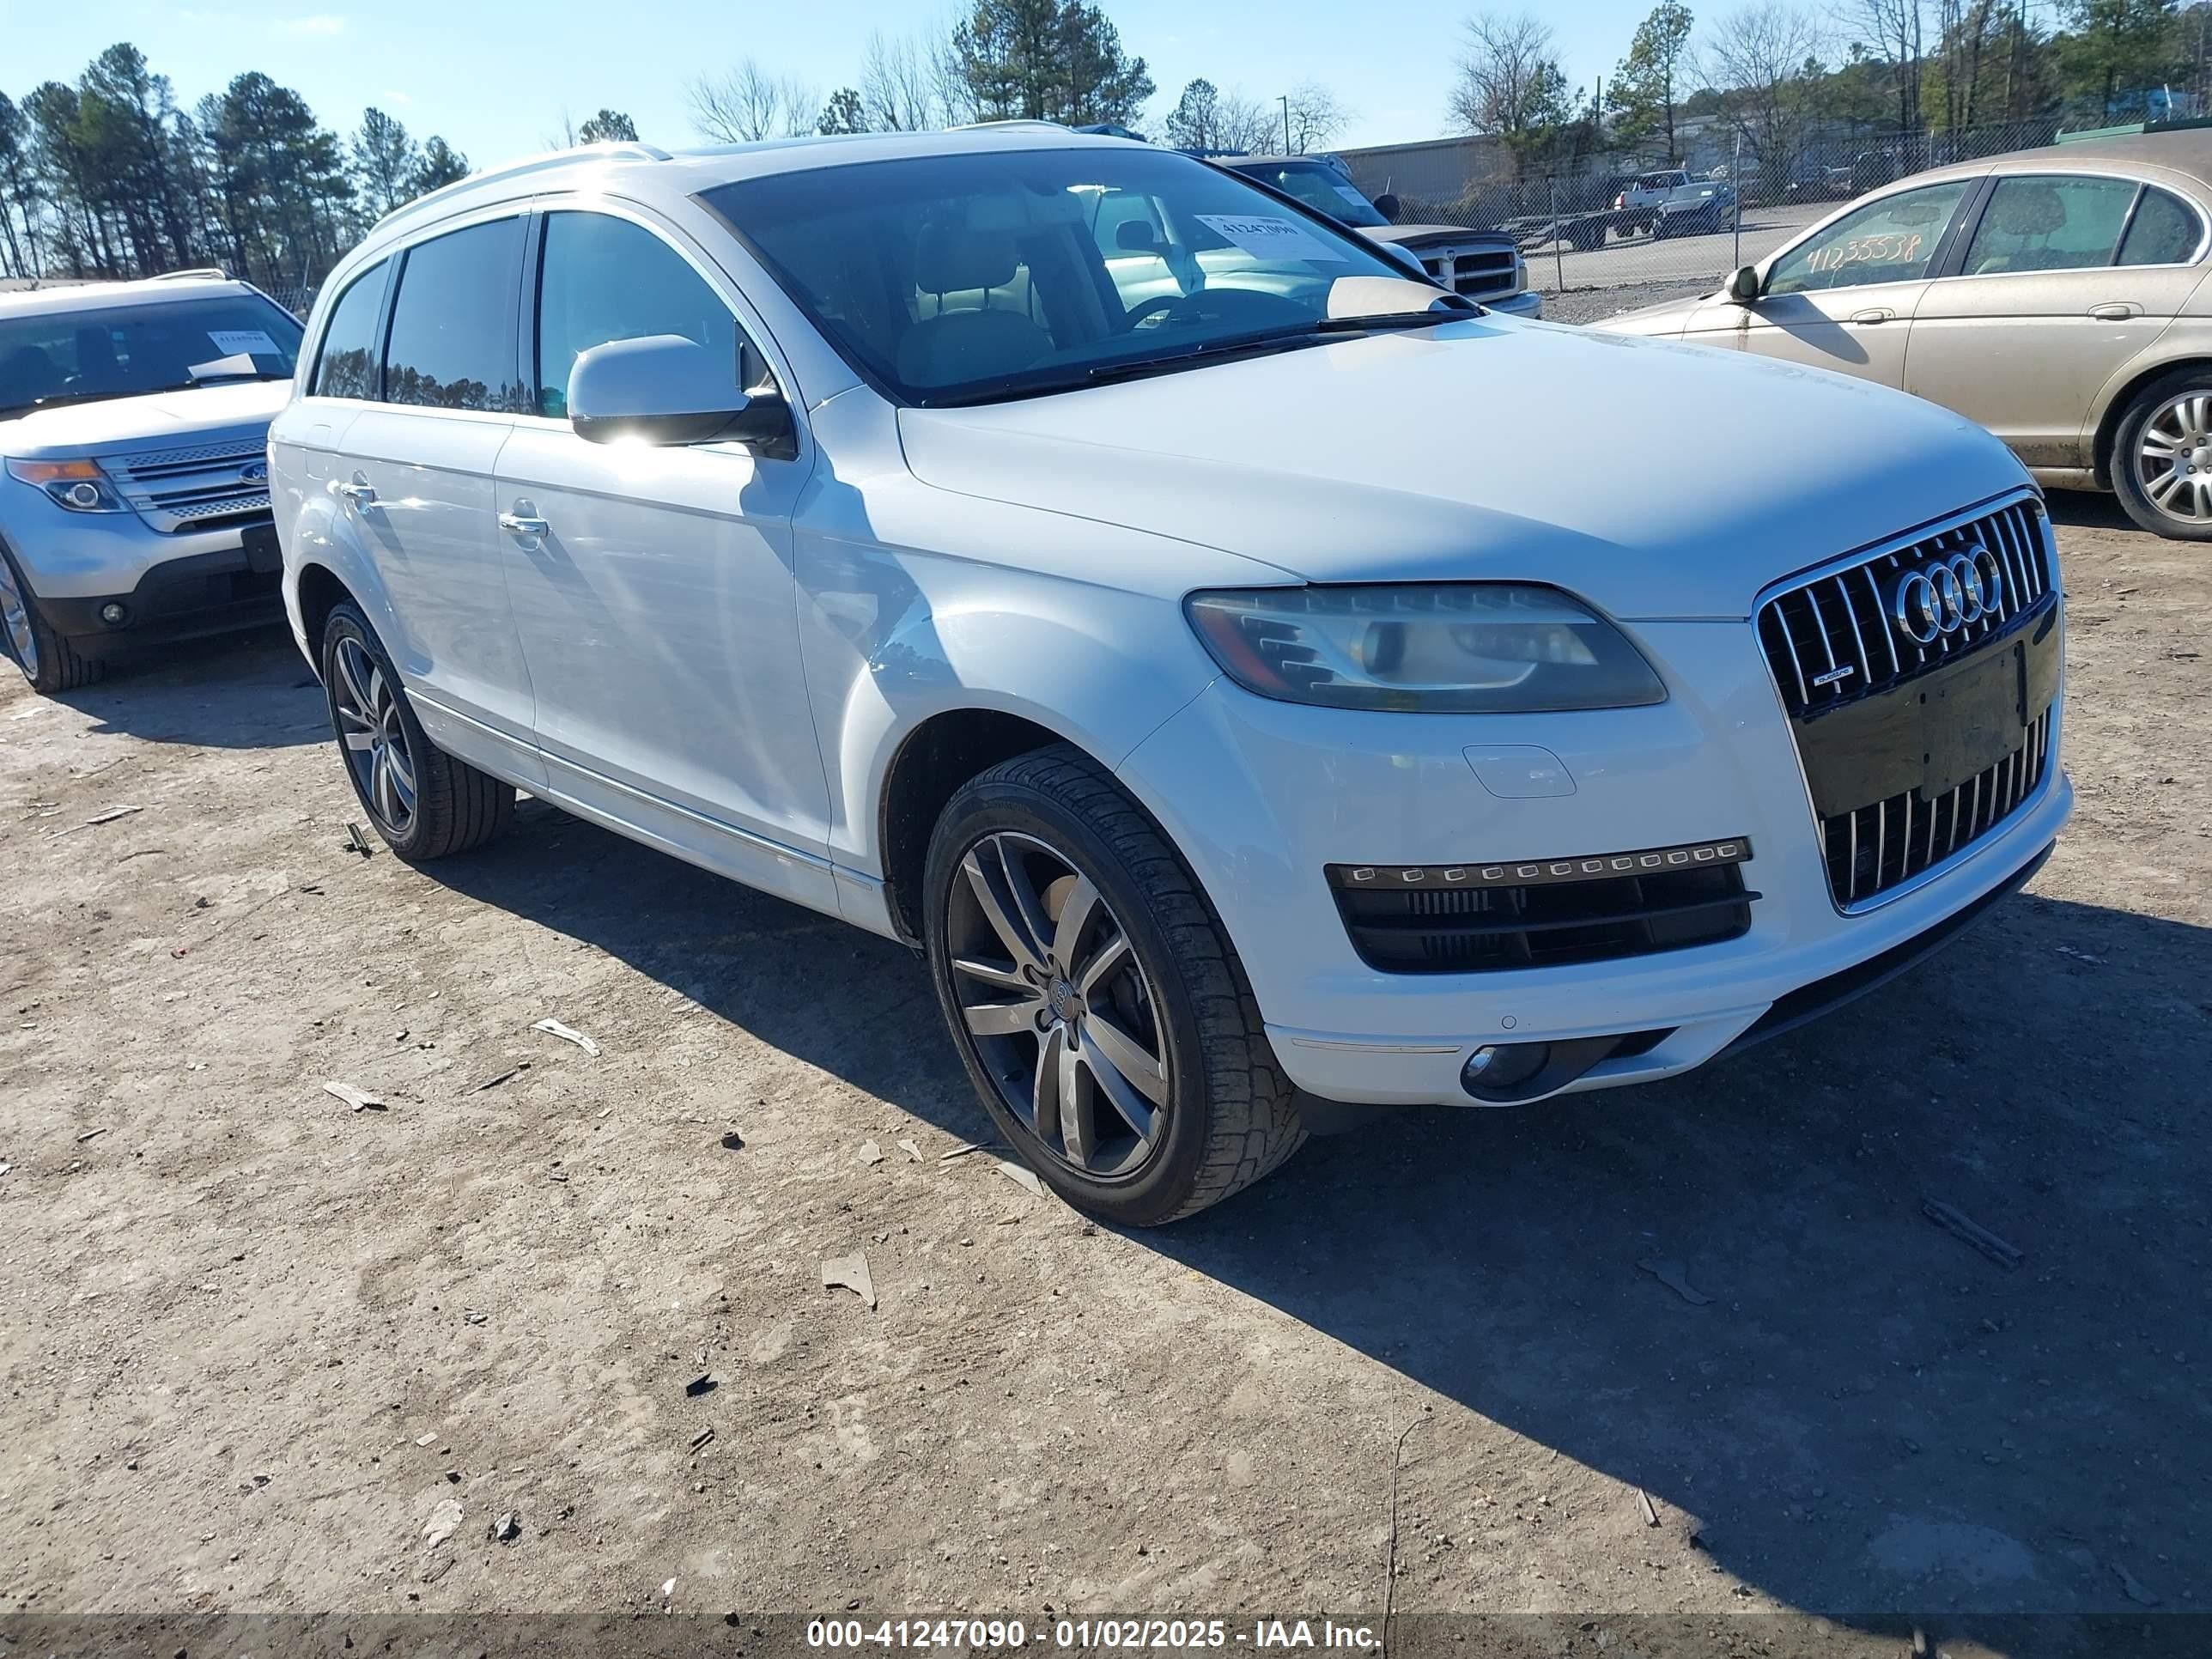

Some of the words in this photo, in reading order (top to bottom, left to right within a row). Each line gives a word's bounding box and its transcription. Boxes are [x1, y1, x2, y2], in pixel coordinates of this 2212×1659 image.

[1222, 224, 1299, 234] 41247090
[1808, 234, 1922, 274] 41235538
[1818, 669, 1850, 683] quattro
